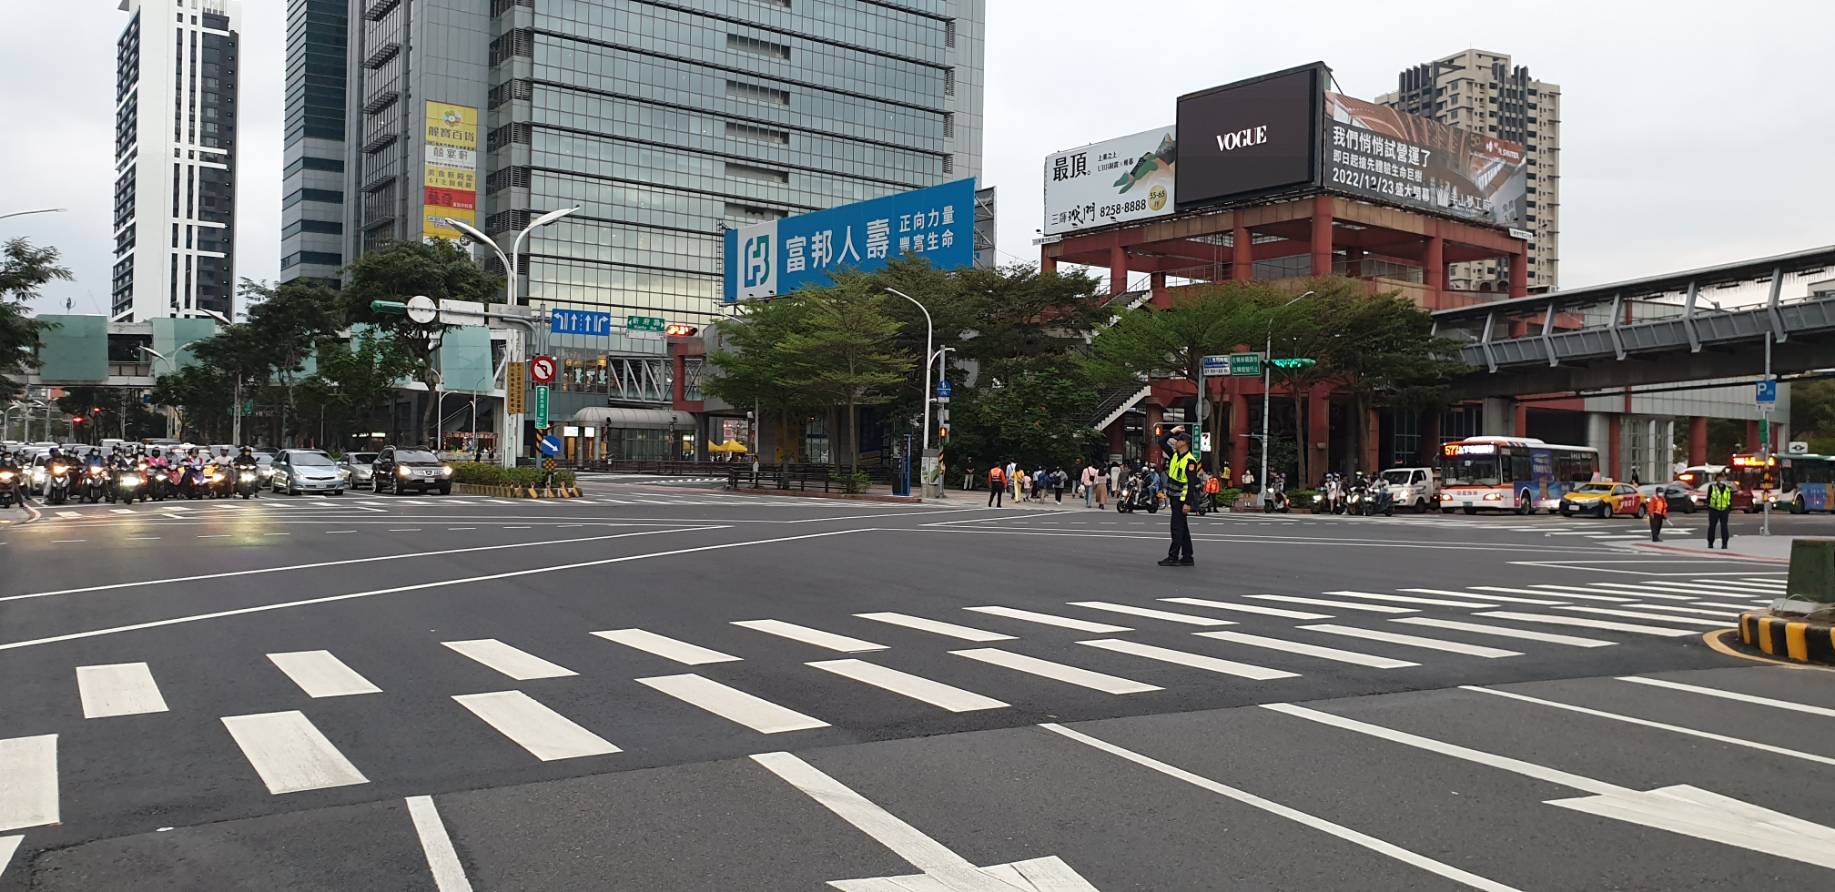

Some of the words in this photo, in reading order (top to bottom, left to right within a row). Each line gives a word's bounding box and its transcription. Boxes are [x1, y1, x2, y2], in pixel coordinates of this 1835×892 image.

[1216, 125, 1267, 152] VOGUE
[1333, 126, 1431, 168] 我們悄悄試營運了
[1333, 149, 1423, 183] 即日起搶先體驗生命巨樹
[899, 205, 955, 233] 正向力量
[1100, 199, 1146, 218] 8258-8888
[786, 218, 890, 274] 富邦人壽
[899, 229, 955, 256] 豐富生命
[1757, 383, 1767, 396] P
[1444, 445, 1458, 456] 577
